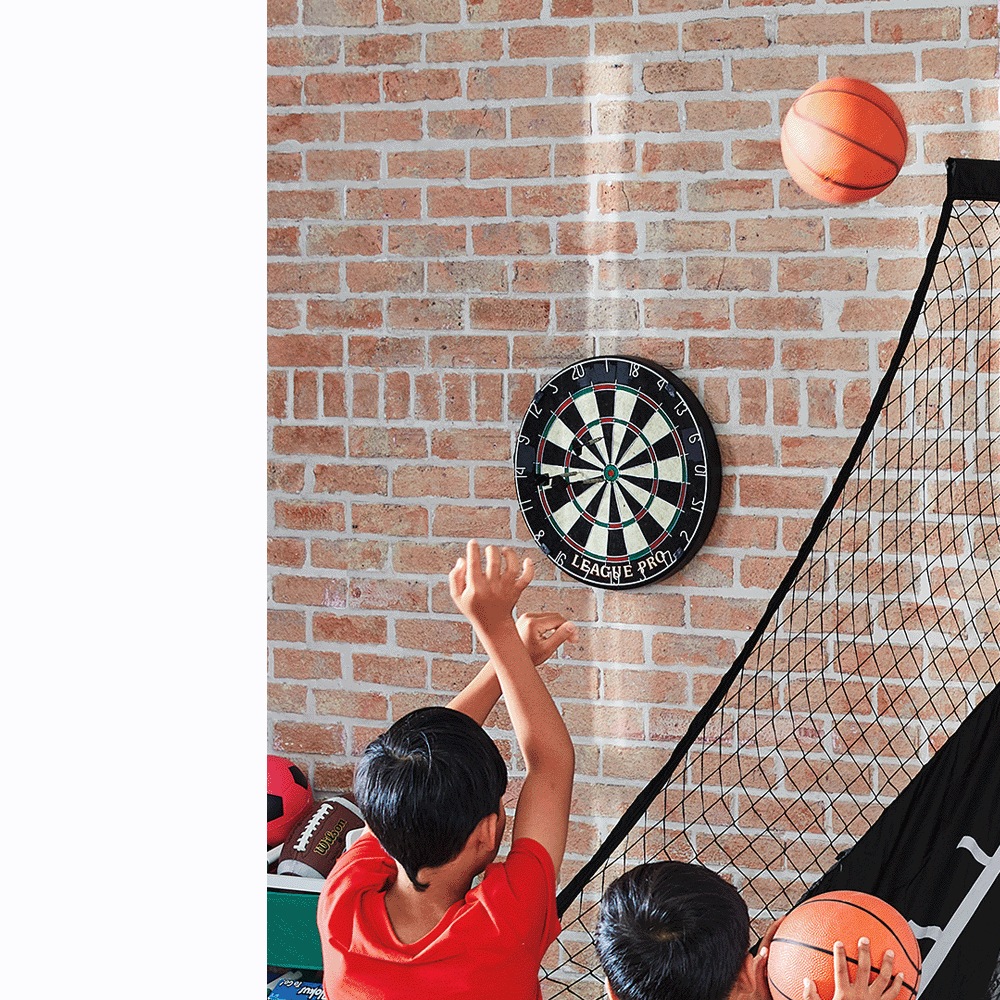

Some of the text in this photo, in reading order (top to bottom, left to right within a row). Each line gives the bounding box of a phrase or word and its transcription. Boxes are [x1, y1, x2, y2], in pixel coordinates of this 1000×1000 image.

[571, 364, 585, 380] 20
[629, 362, 640, 378] 18
[656, 379, 666, 391] 4
[529, 402, 543, 418] 12
[674, 400, 689, 416] 13
[518, 434, 530, 446] 9
[689, 433, 701, 444] 6
[515, 466, 528, 479] 14
[694, 464, 708, 477] 10
[535, 529, 545, 541] 8
[554, 550, 567, 566] 16
[571, 550, 665, 579] LEAGUE PRO
[313, 818, 348, 856] Wilson
[279, 979, 303, 988] To Go!
